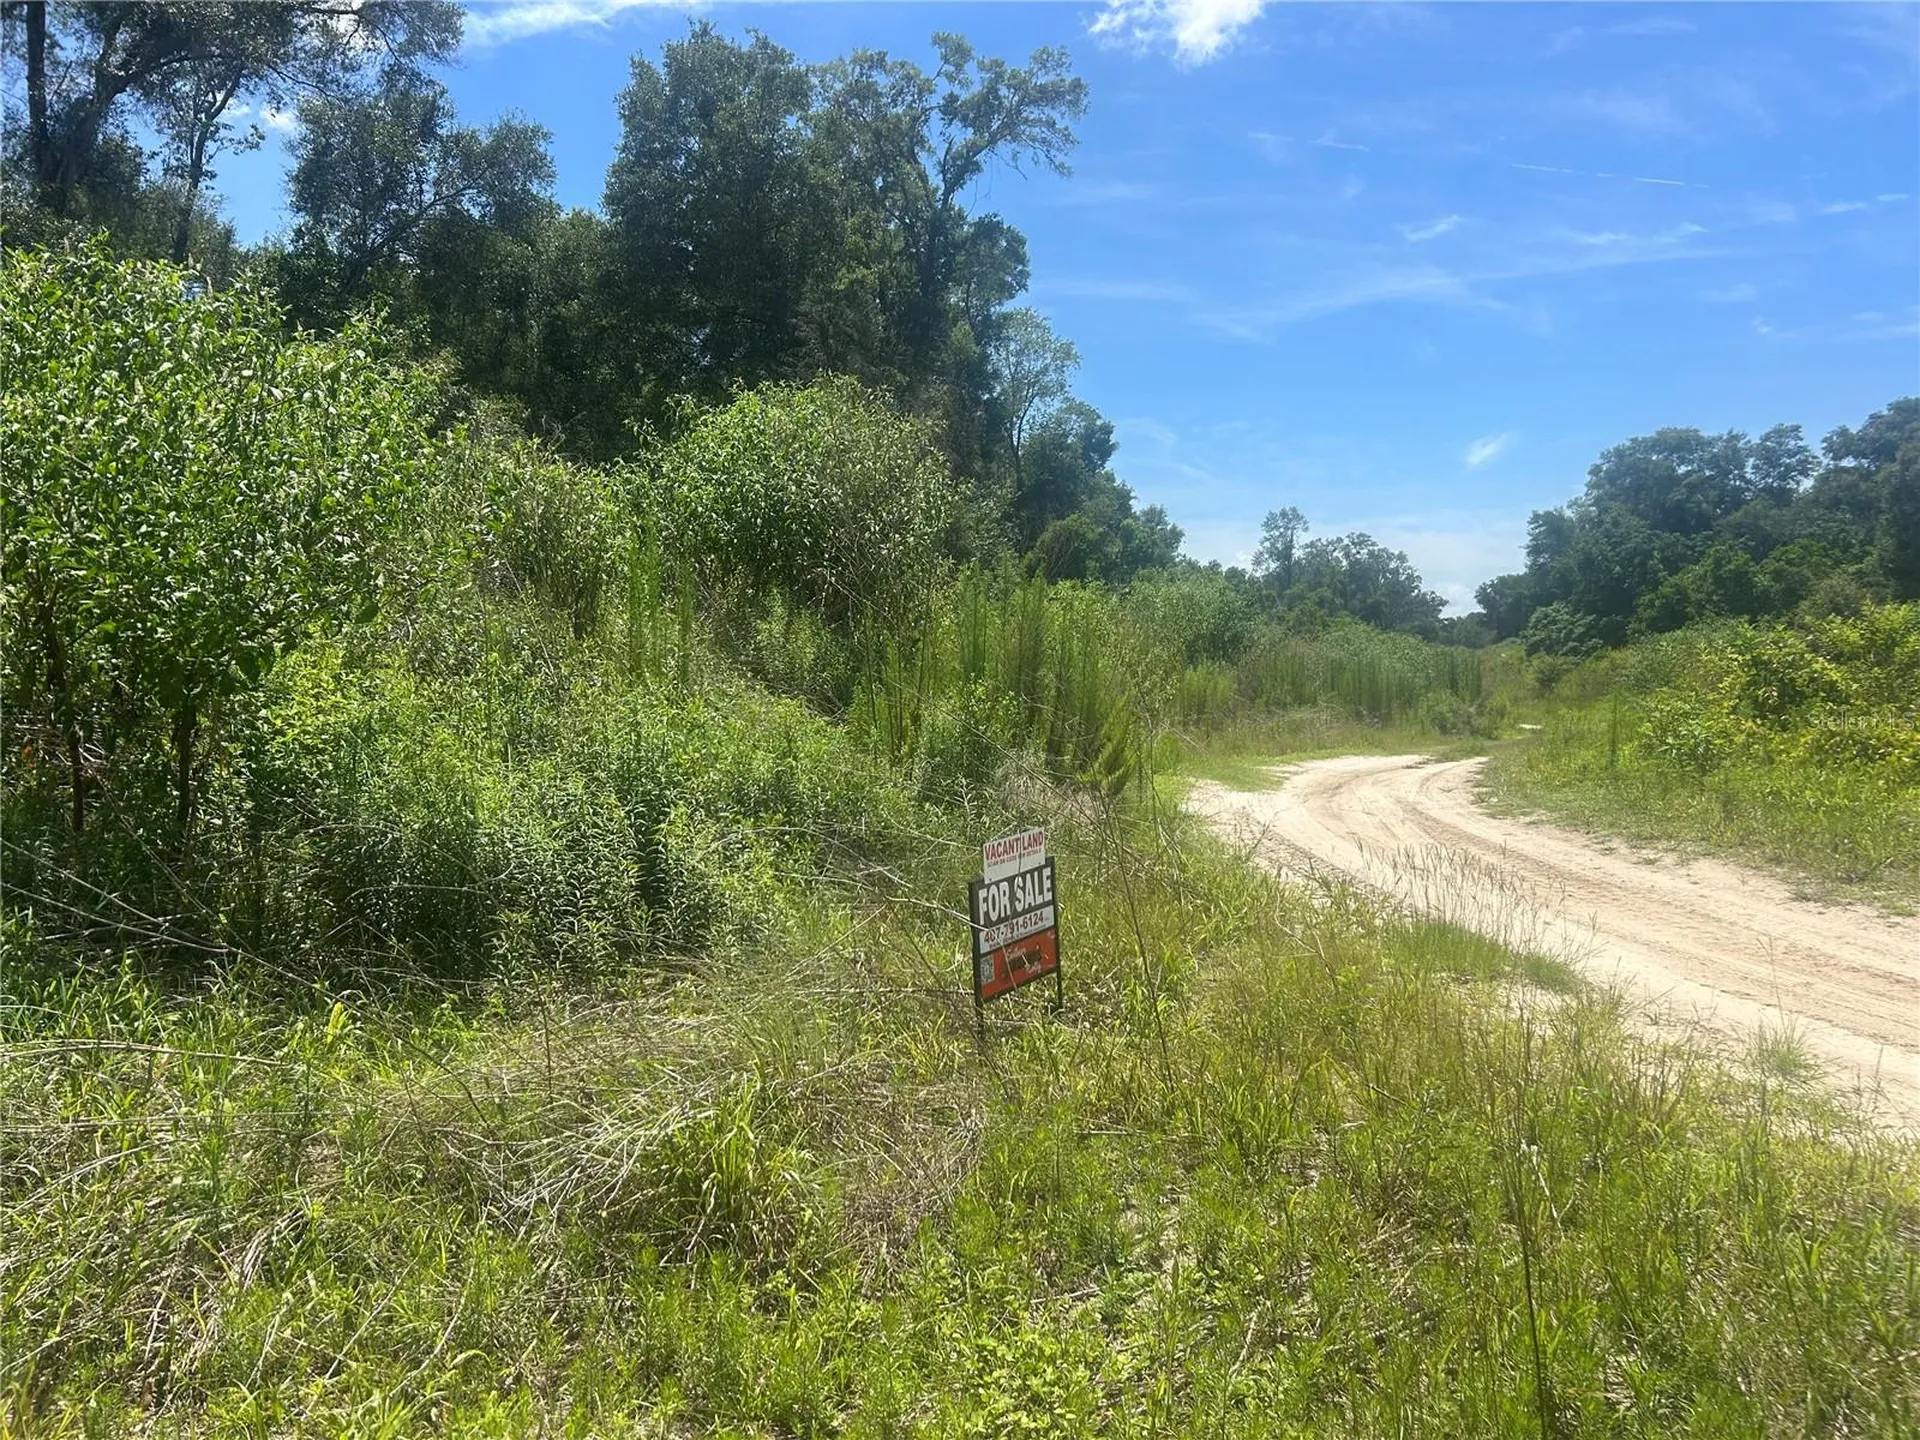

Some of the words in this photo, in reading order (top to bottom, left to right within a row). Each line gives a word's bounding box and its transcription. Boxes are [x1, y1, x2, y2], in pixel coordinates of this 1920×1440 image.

[985, 837, 1018, 861] VACANT
[1022, 831, 1044, 851] LAND
[978, 881, 1011, 925] FOR
[1014, 866, 1052, 912] SALE
